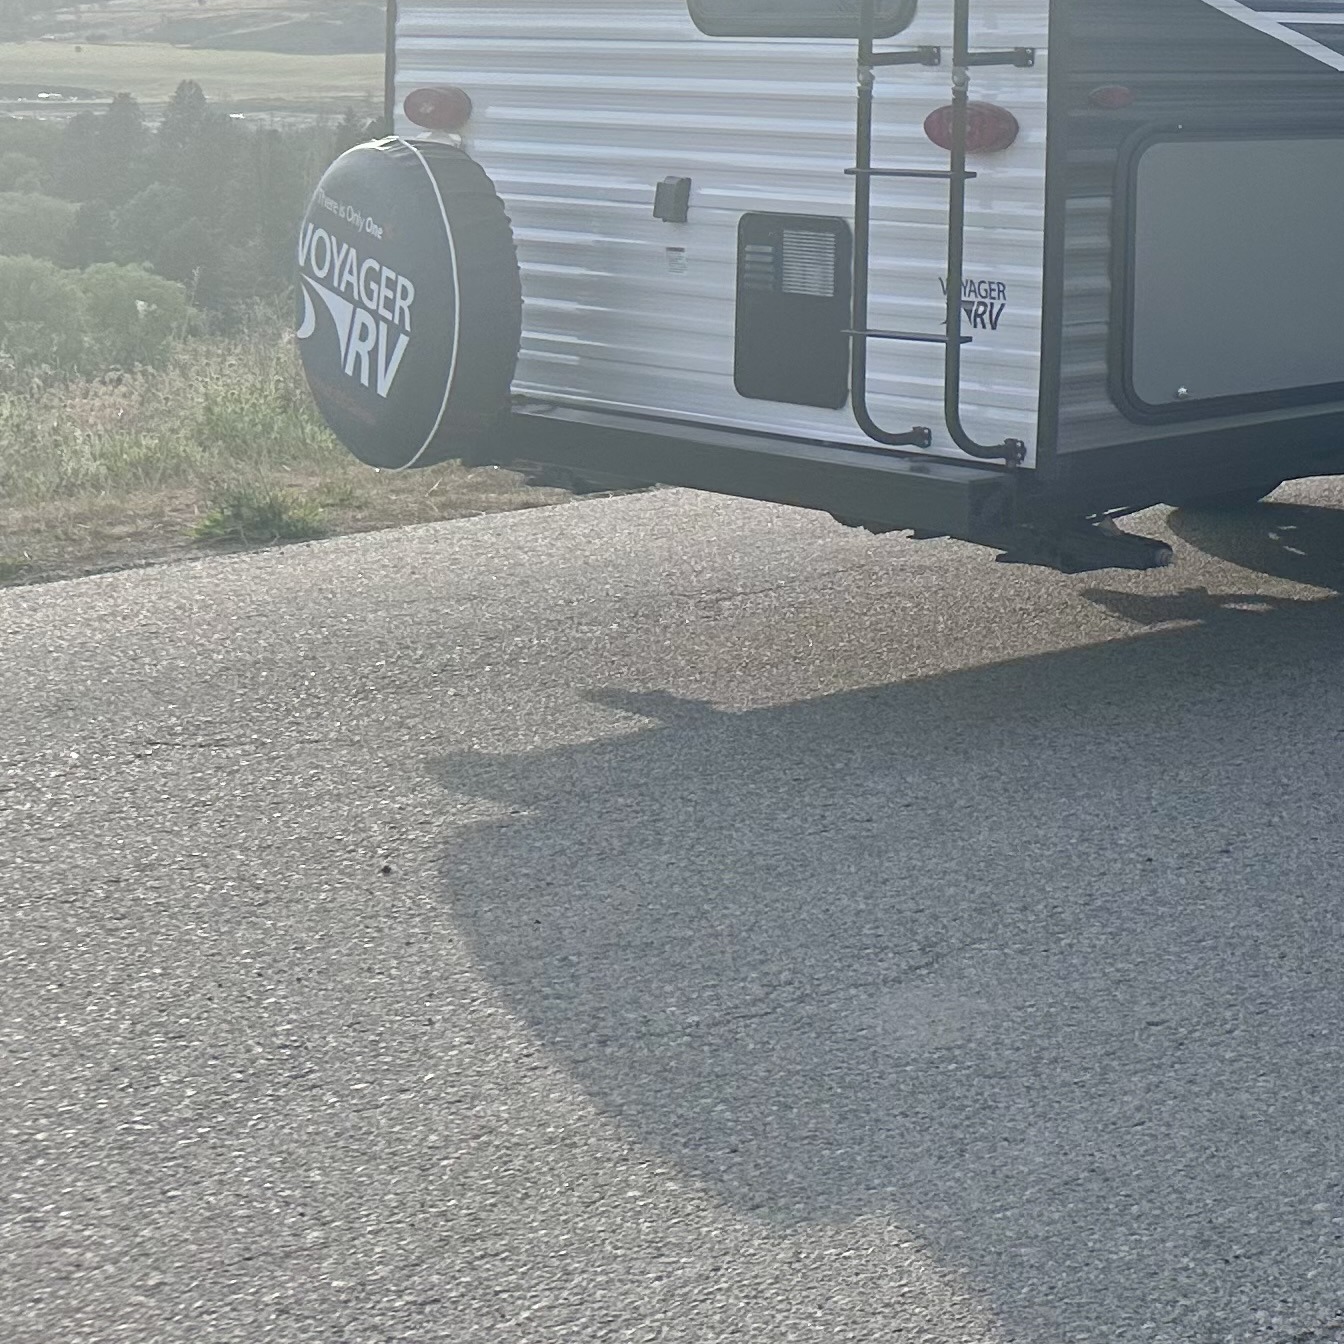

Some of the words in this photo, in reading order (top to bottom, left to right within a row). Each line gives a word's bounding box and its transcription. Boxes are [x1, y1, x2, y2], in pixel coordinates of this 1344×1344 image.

[339, 201, 346, 219] is
[346, 205, 365, 233] Only
[365, 216, 383, 240] One
[299, 222, 415, 332] VOYAGER
[938, 276, 1007, 301] VYAGER
[973, 300, 1006, 331] RV
[345, 307, 410, 398] RV
